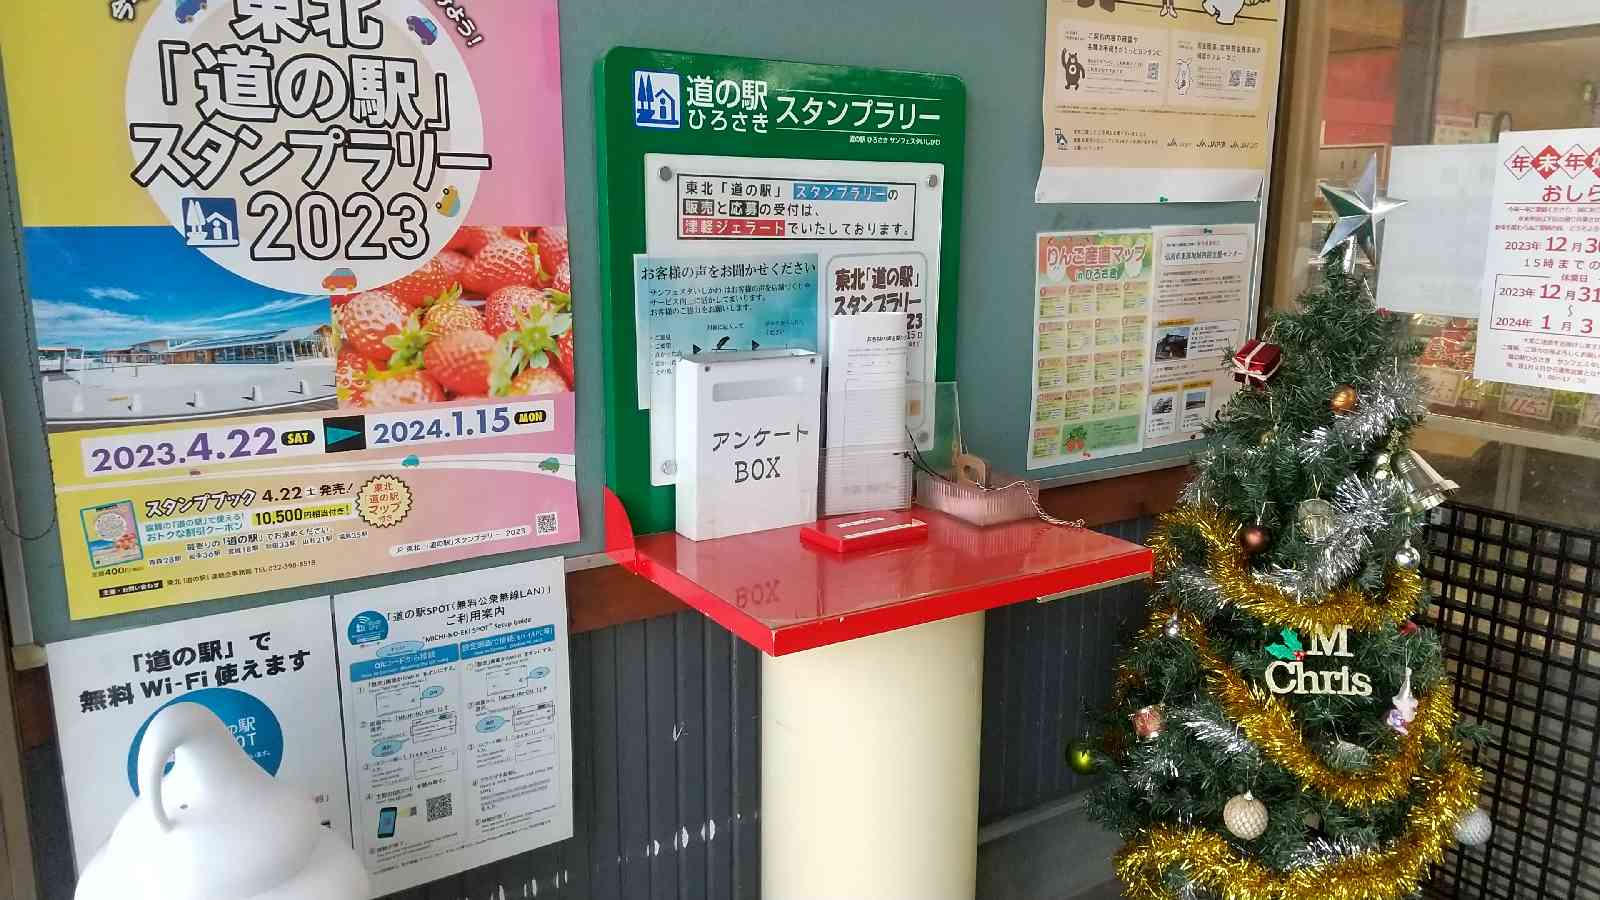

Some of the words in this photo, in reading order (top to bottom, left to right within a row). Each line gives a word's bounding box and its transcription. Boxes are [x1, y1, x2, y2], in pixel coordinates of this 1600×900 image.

[157, 40, 450, 132] 「道の駅」
[686, 74, 768, 111] 道の駅
[688, 109, 769, 134] ひろさき
[776, 96, 941, 130] スタンプラリー
[129, 122, 492, 192] スタンプラリー
[246, 190, 430, 261] 2023
[641, 261, 816, 281] お客様の声をお聞かせください
[1047, 245, 1146, 266] りんご産直マップ
[834, 264, 920, 292] 東北「道の駅」
[834, 291, 922, 316] スタンプラリー
[373, 407, 510, 444] 2024.1.15
[518, 411, 544, 423] MON
[712, 423, 809, 452] アンケート
[91, 427, 278, 473] 2023.4.22
[287, 430, 310, 445] SAT
[734, 456, 781, 484] BOX
[145, 488, 257, 519] スタンプブック
[446, 607, 506, 626] ご利用案内
[1306, 624, 1355, 657] M
[140, 671, 209, 698] Wi-Fi
[214, 650, 311, 687] 使えます
[1265, 660, 1373, 697] Chris
